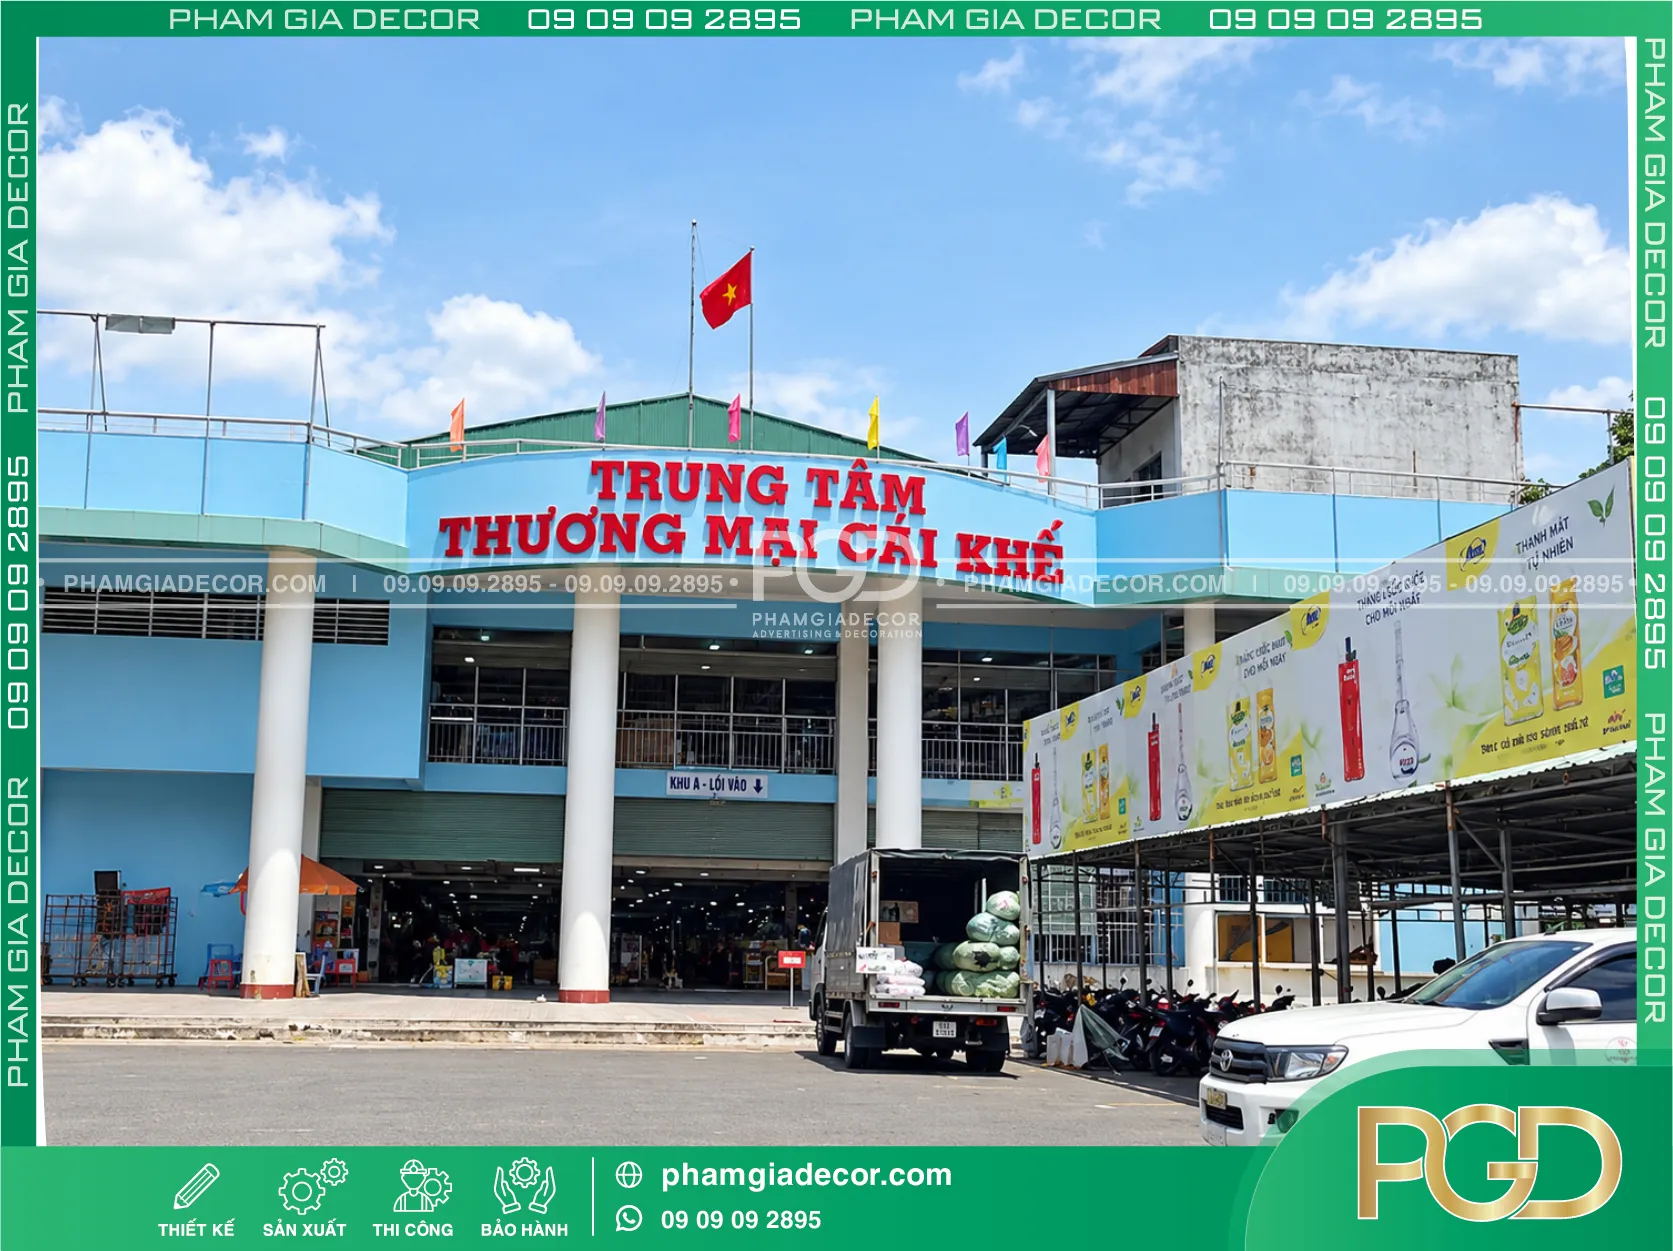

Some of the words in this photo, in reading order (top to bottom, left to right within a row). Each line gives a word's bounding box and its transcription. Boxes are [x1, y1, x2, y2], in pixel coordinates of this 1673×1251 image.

[591, 460, 788, 506] TRUNG
[807, 458, 926, 515] TÂM
[439, 505, 686, 556] THƯƠNG
[705, 515, 818, 567] MẠI
[838, 514, 938, 568] CÁI
[956, 519, 1064, 584] KHẾ
[1515, 528, 1547, 554] THANH
[670, 776, 690, 789] KHU
[693, 777, 700, 790] A
